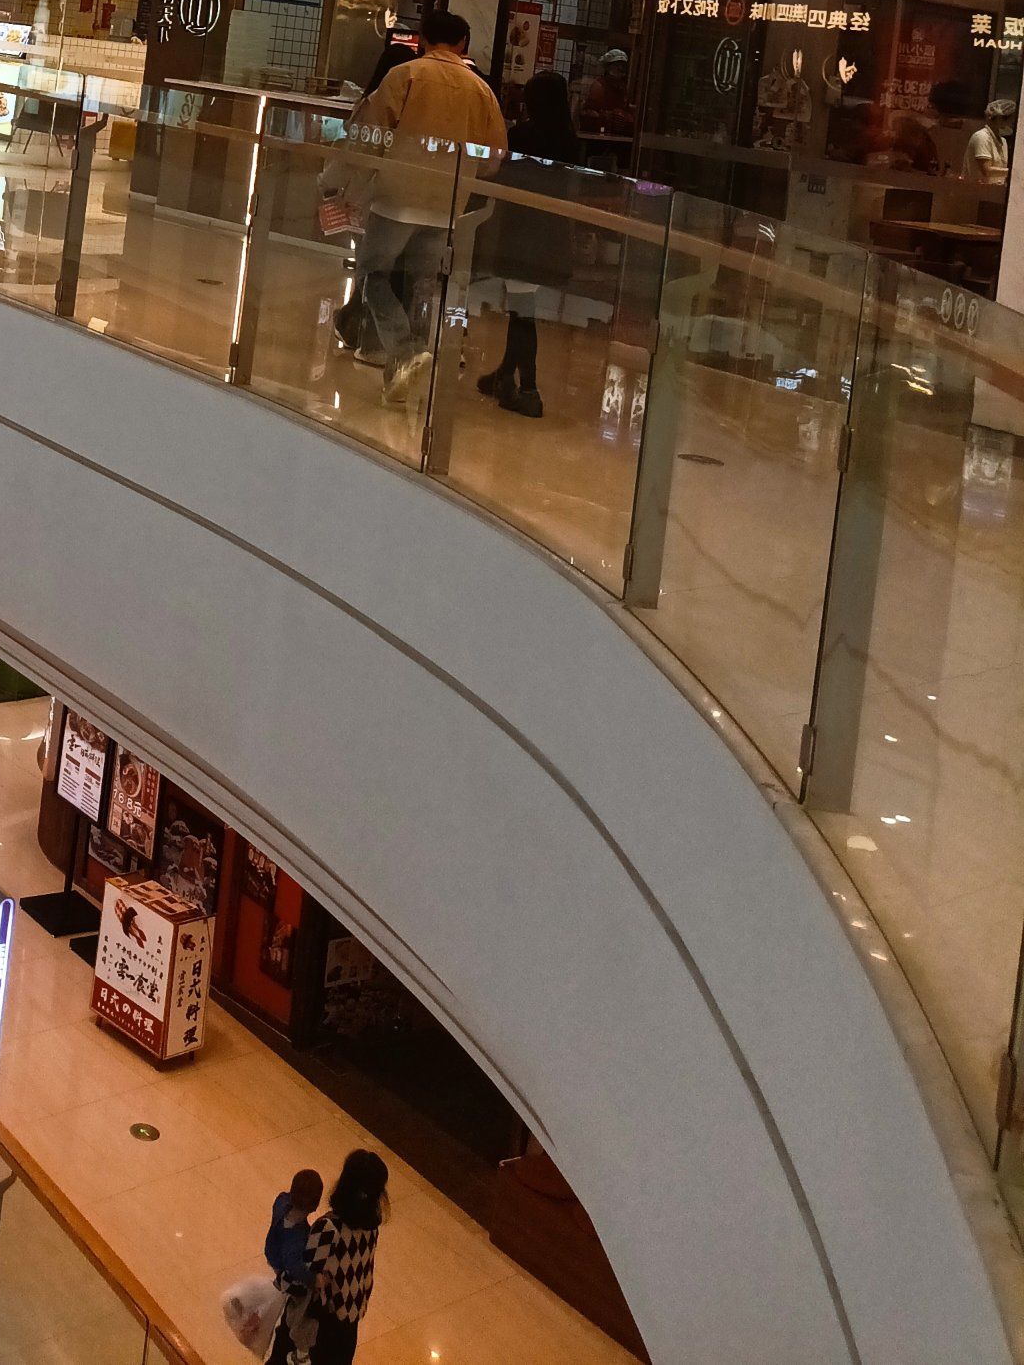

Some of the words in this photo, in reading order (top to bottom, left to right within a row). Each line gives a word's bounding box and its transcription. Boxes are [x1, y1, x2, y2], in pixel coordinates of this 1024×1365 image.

[100, 987, 155, 1036] 日式の料理
